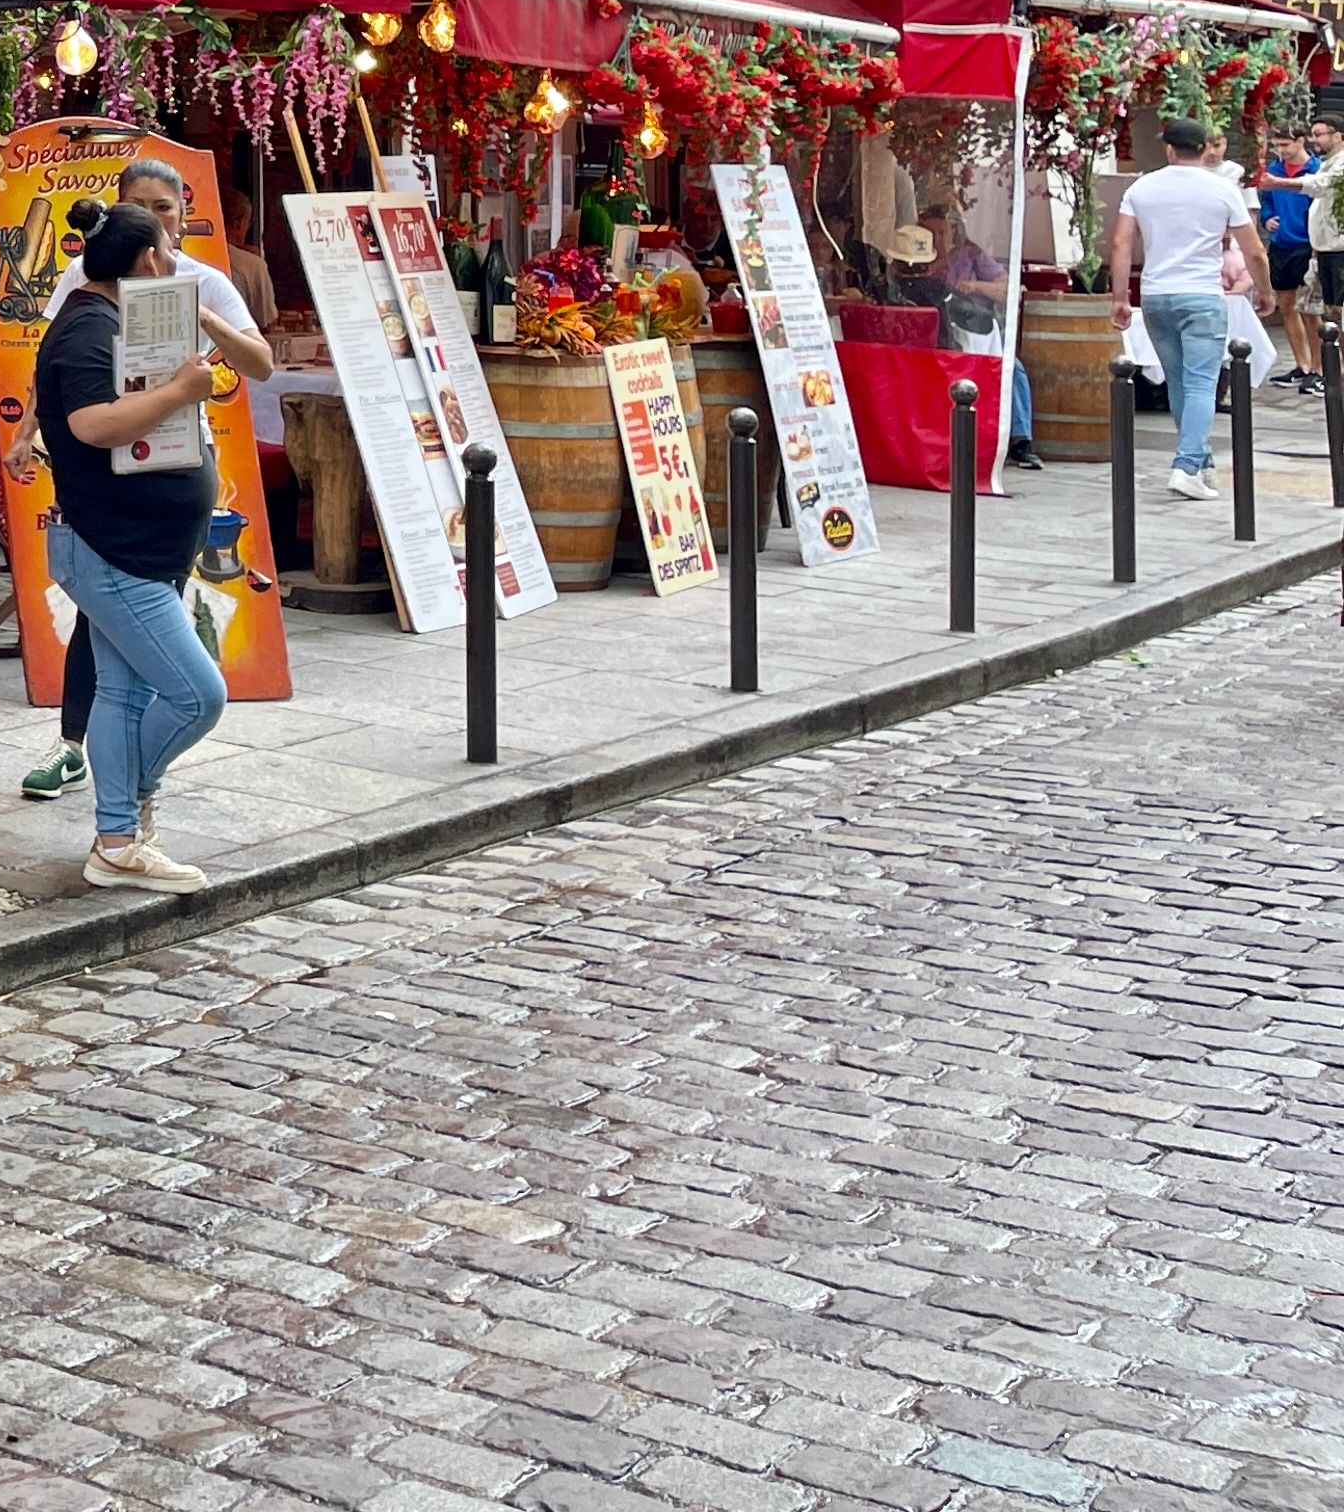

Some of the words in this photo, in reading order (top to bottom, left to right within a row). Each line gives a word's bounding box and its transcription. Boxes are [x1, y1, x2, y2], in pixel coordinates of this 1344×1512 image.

[22, 326, 40, 338] La
[647, 393, 675, 417] HAPPY
[653, 415, 683, 438] HOURS
[678, 532, 697, 553] BAR
[657, 562, 673, 583] DES
[674, 554, 702, 575] SPRITZ
